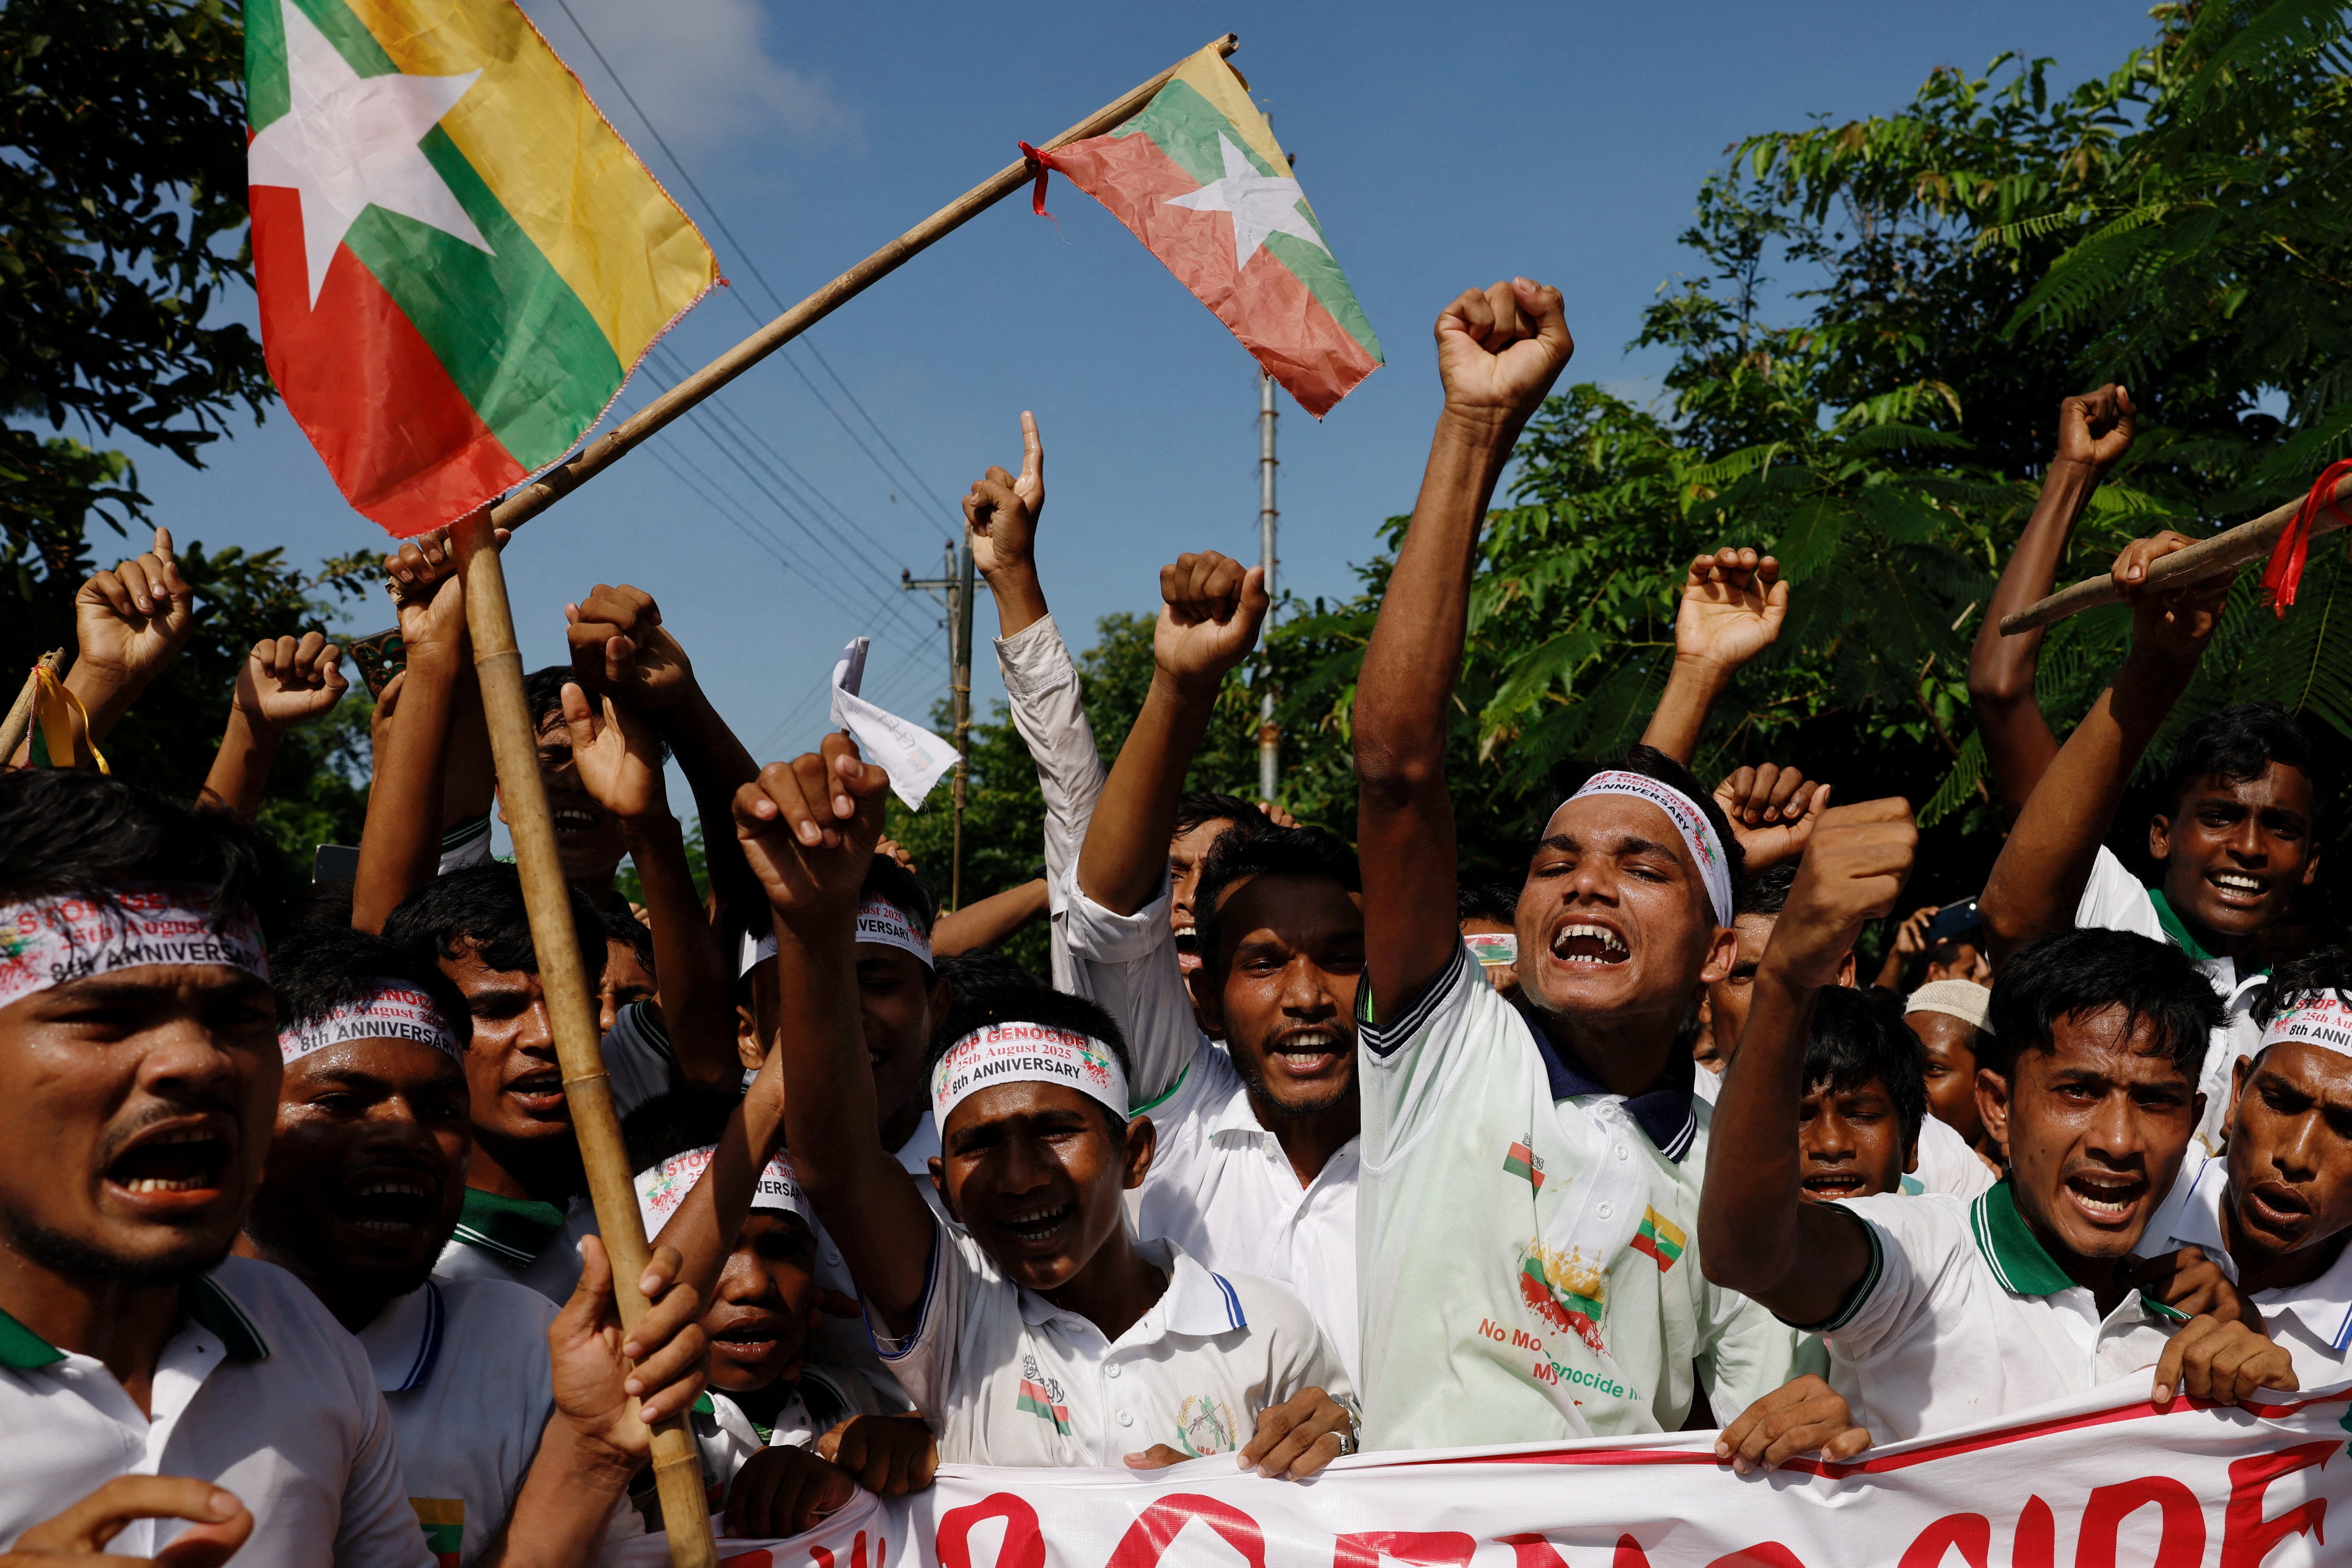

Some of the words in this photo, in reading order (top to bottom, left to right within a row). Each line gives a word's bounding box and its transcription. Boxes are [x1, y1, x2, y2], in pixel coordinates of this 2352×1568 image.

[1591, 784, 1689, 830] ANNIVERSARY
[1611, 777, 1660, 793] August
[1662, 793, 1688, 817] 2025
[125, 918, 207, 939] August
[883, 908, 902, 923] 2025
[107, 943, 260, 973] ANNIVERSARY
[353, 1004, 416, 1018] August
[2295, 998, 2338, 1011] STOP
[2289, 1024, 2308, 1035] 8th
[2311, 1026, 2352, 1048] ANNI
[2302, 1012, 2328, 1023] 25th
[2331, 1016, 2352, 1032] Au
[301, 1031, 329, 1052] 8th
[337, 1021, 454, 1056] ANNIVERSARY
[944, 1035, 981, 1071] STOP
[986, 1026, 1090, 1053] GENOCIDE!
[957, 1053, 981, 1073] 25th
[985, 1044, 1037, 1059] August
[1042, 1044, 1071, 1059] 2025
[952, 1075, 968, 1095] 8th
[973, 1058, 1080, 1081] ANNIVERSARY
[777, 1166, 796, 1181] 202
[1478, 1318, 1506, 1341] No
[1512, 1329, 1543, 1351] Mo
[1546, 1351, 1624, 1398] enocide
